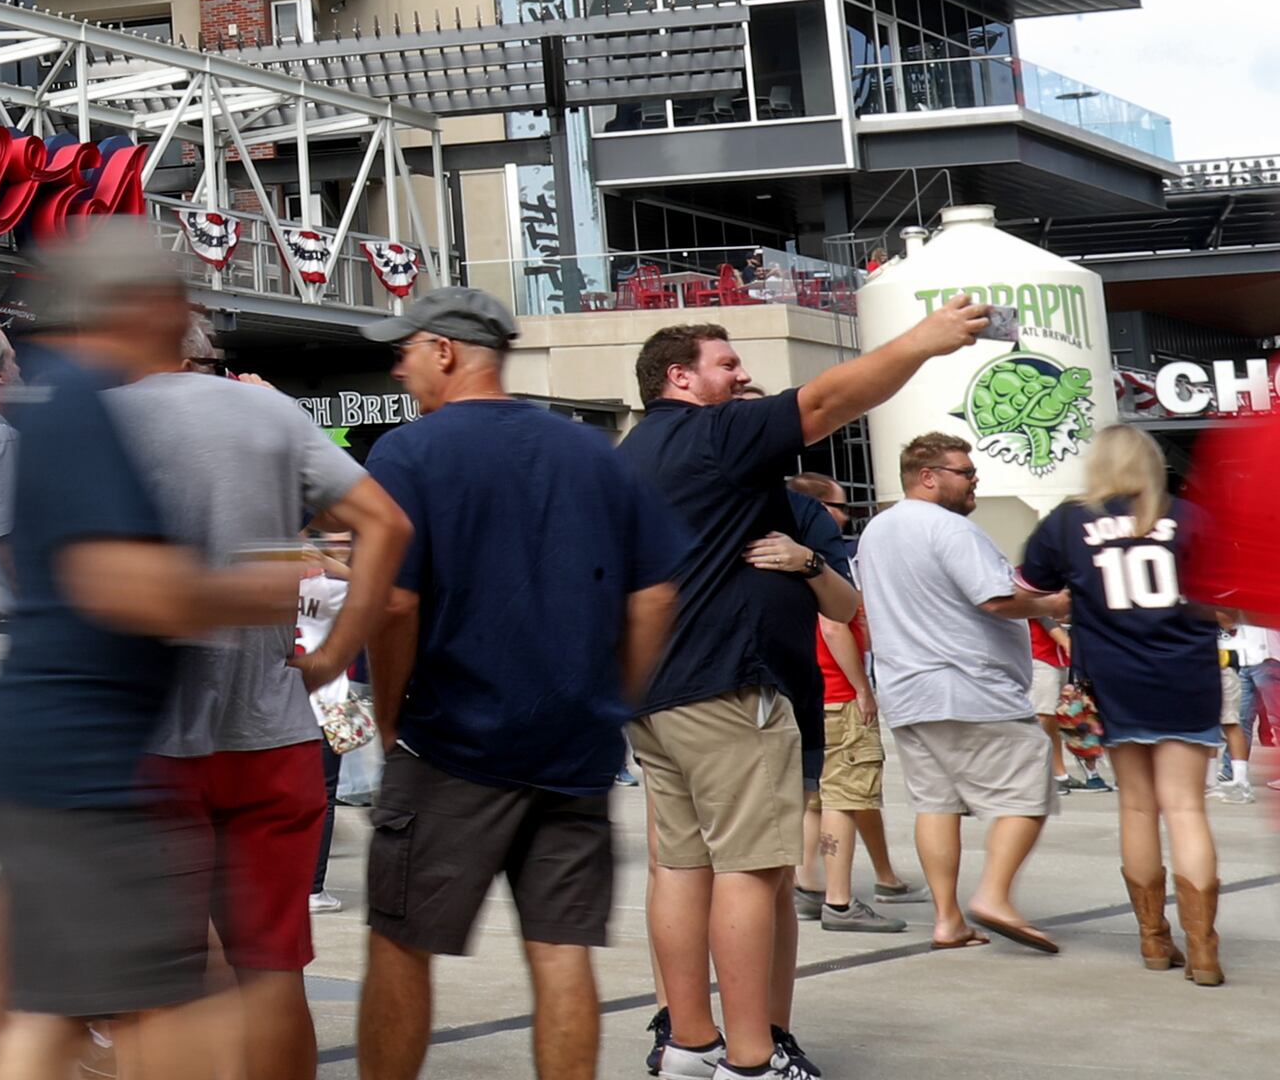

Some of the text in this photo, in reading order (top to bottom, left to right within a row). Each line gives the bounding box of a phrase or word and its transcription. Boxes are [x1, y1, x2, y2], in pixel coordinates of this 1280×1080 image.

[1022, 327, 1041, 338] ATL
[1083, 516, 1178, 547] JONS
[1093, 544, 1180, 610] 10
